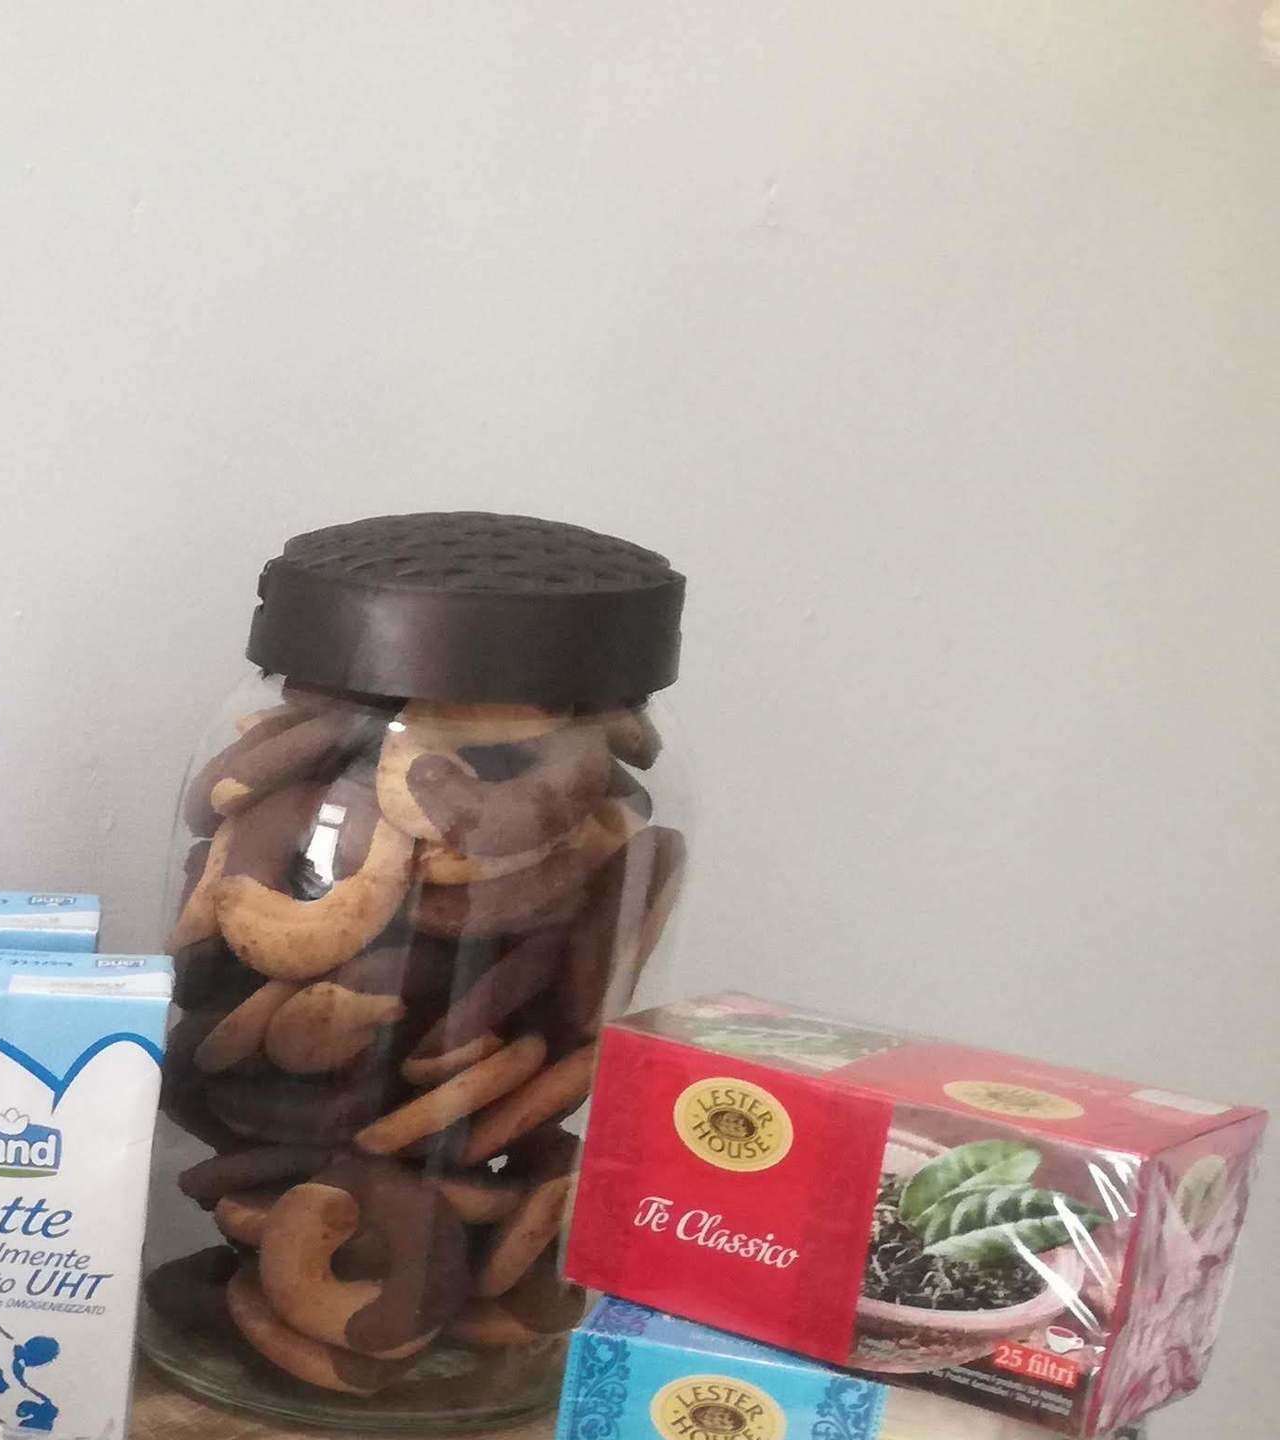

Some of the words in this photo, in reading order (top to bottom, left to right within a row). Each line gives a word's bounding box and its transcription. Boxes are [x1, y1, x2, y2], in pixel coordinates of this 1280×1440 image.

[696, 1088, 774, 1129] LESTER
[691, 1121, 771, 1159] HOUSE
[633, 1195, 675, 1233] Tè
[676, 1209, 800, 1269] Classico
[25, 1269, 114, 1301] UHT
[995, 1345, 1024, 1368] 25
[1026, 1353, 1077, 1388] filtri
[676, 1384, 765, 1422] LESTER
